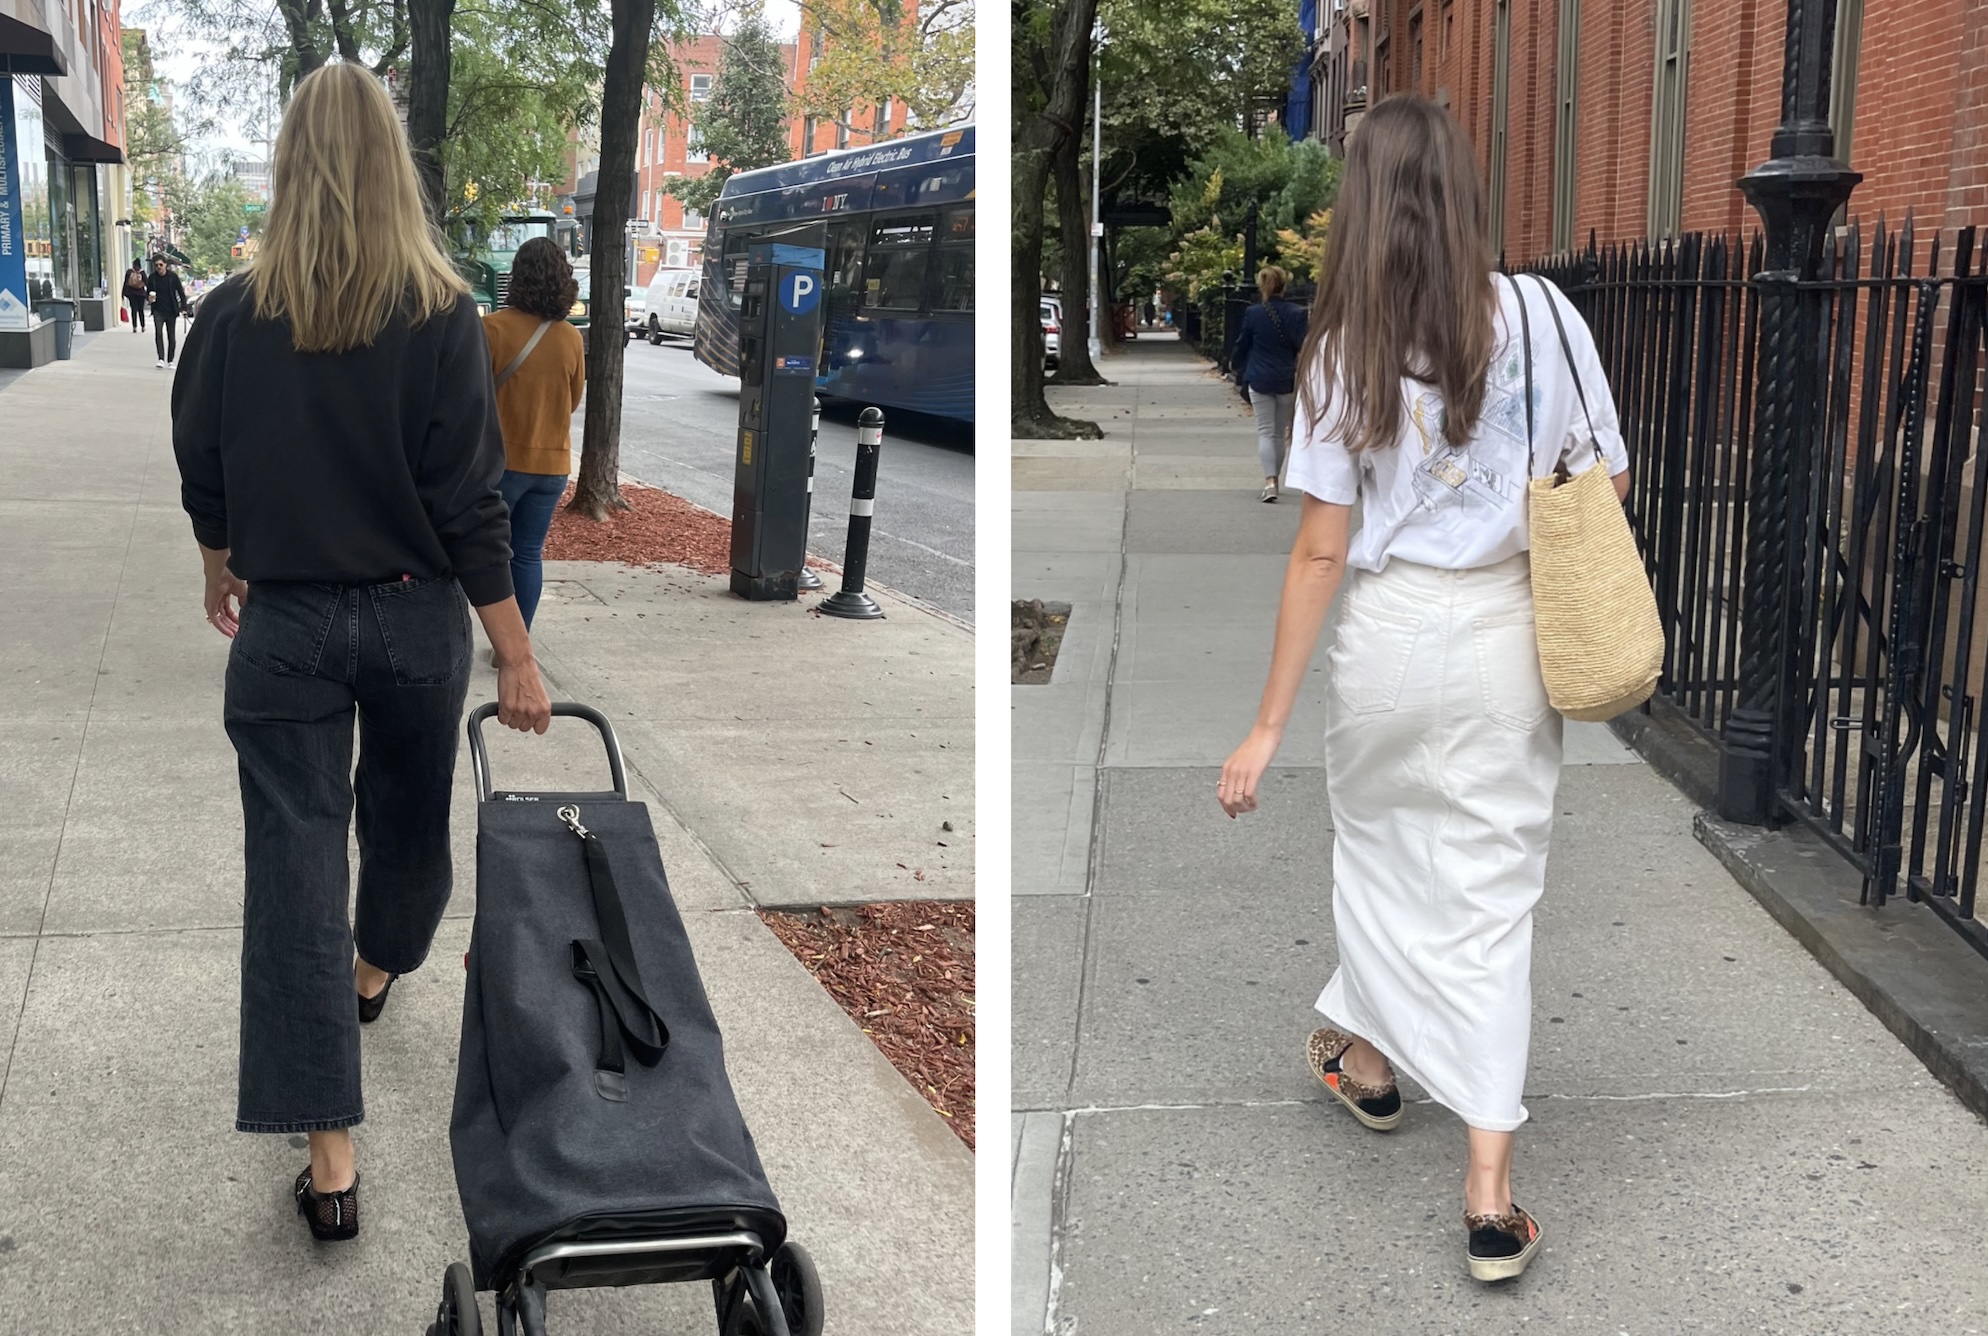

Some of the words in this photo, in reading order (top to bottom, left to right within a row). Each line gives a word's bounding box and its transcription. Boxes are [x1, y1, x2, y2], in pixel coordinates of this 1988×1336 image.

[0, 115, 8, 196] MULTISPECI
[827, 161, 844, 174] Clean
[841, 158, 853, 171] Air
[851, 153, 875, 171] Hybrid
[872, 148, 898, 165] Electric
[897, 147, 913, 160] Bus
[0, 201, 9, 209] &
[832, 193, 848, 210] NY
[0, 211, 12, 256] PRIMARY
[792, 275, 814, 308] P
